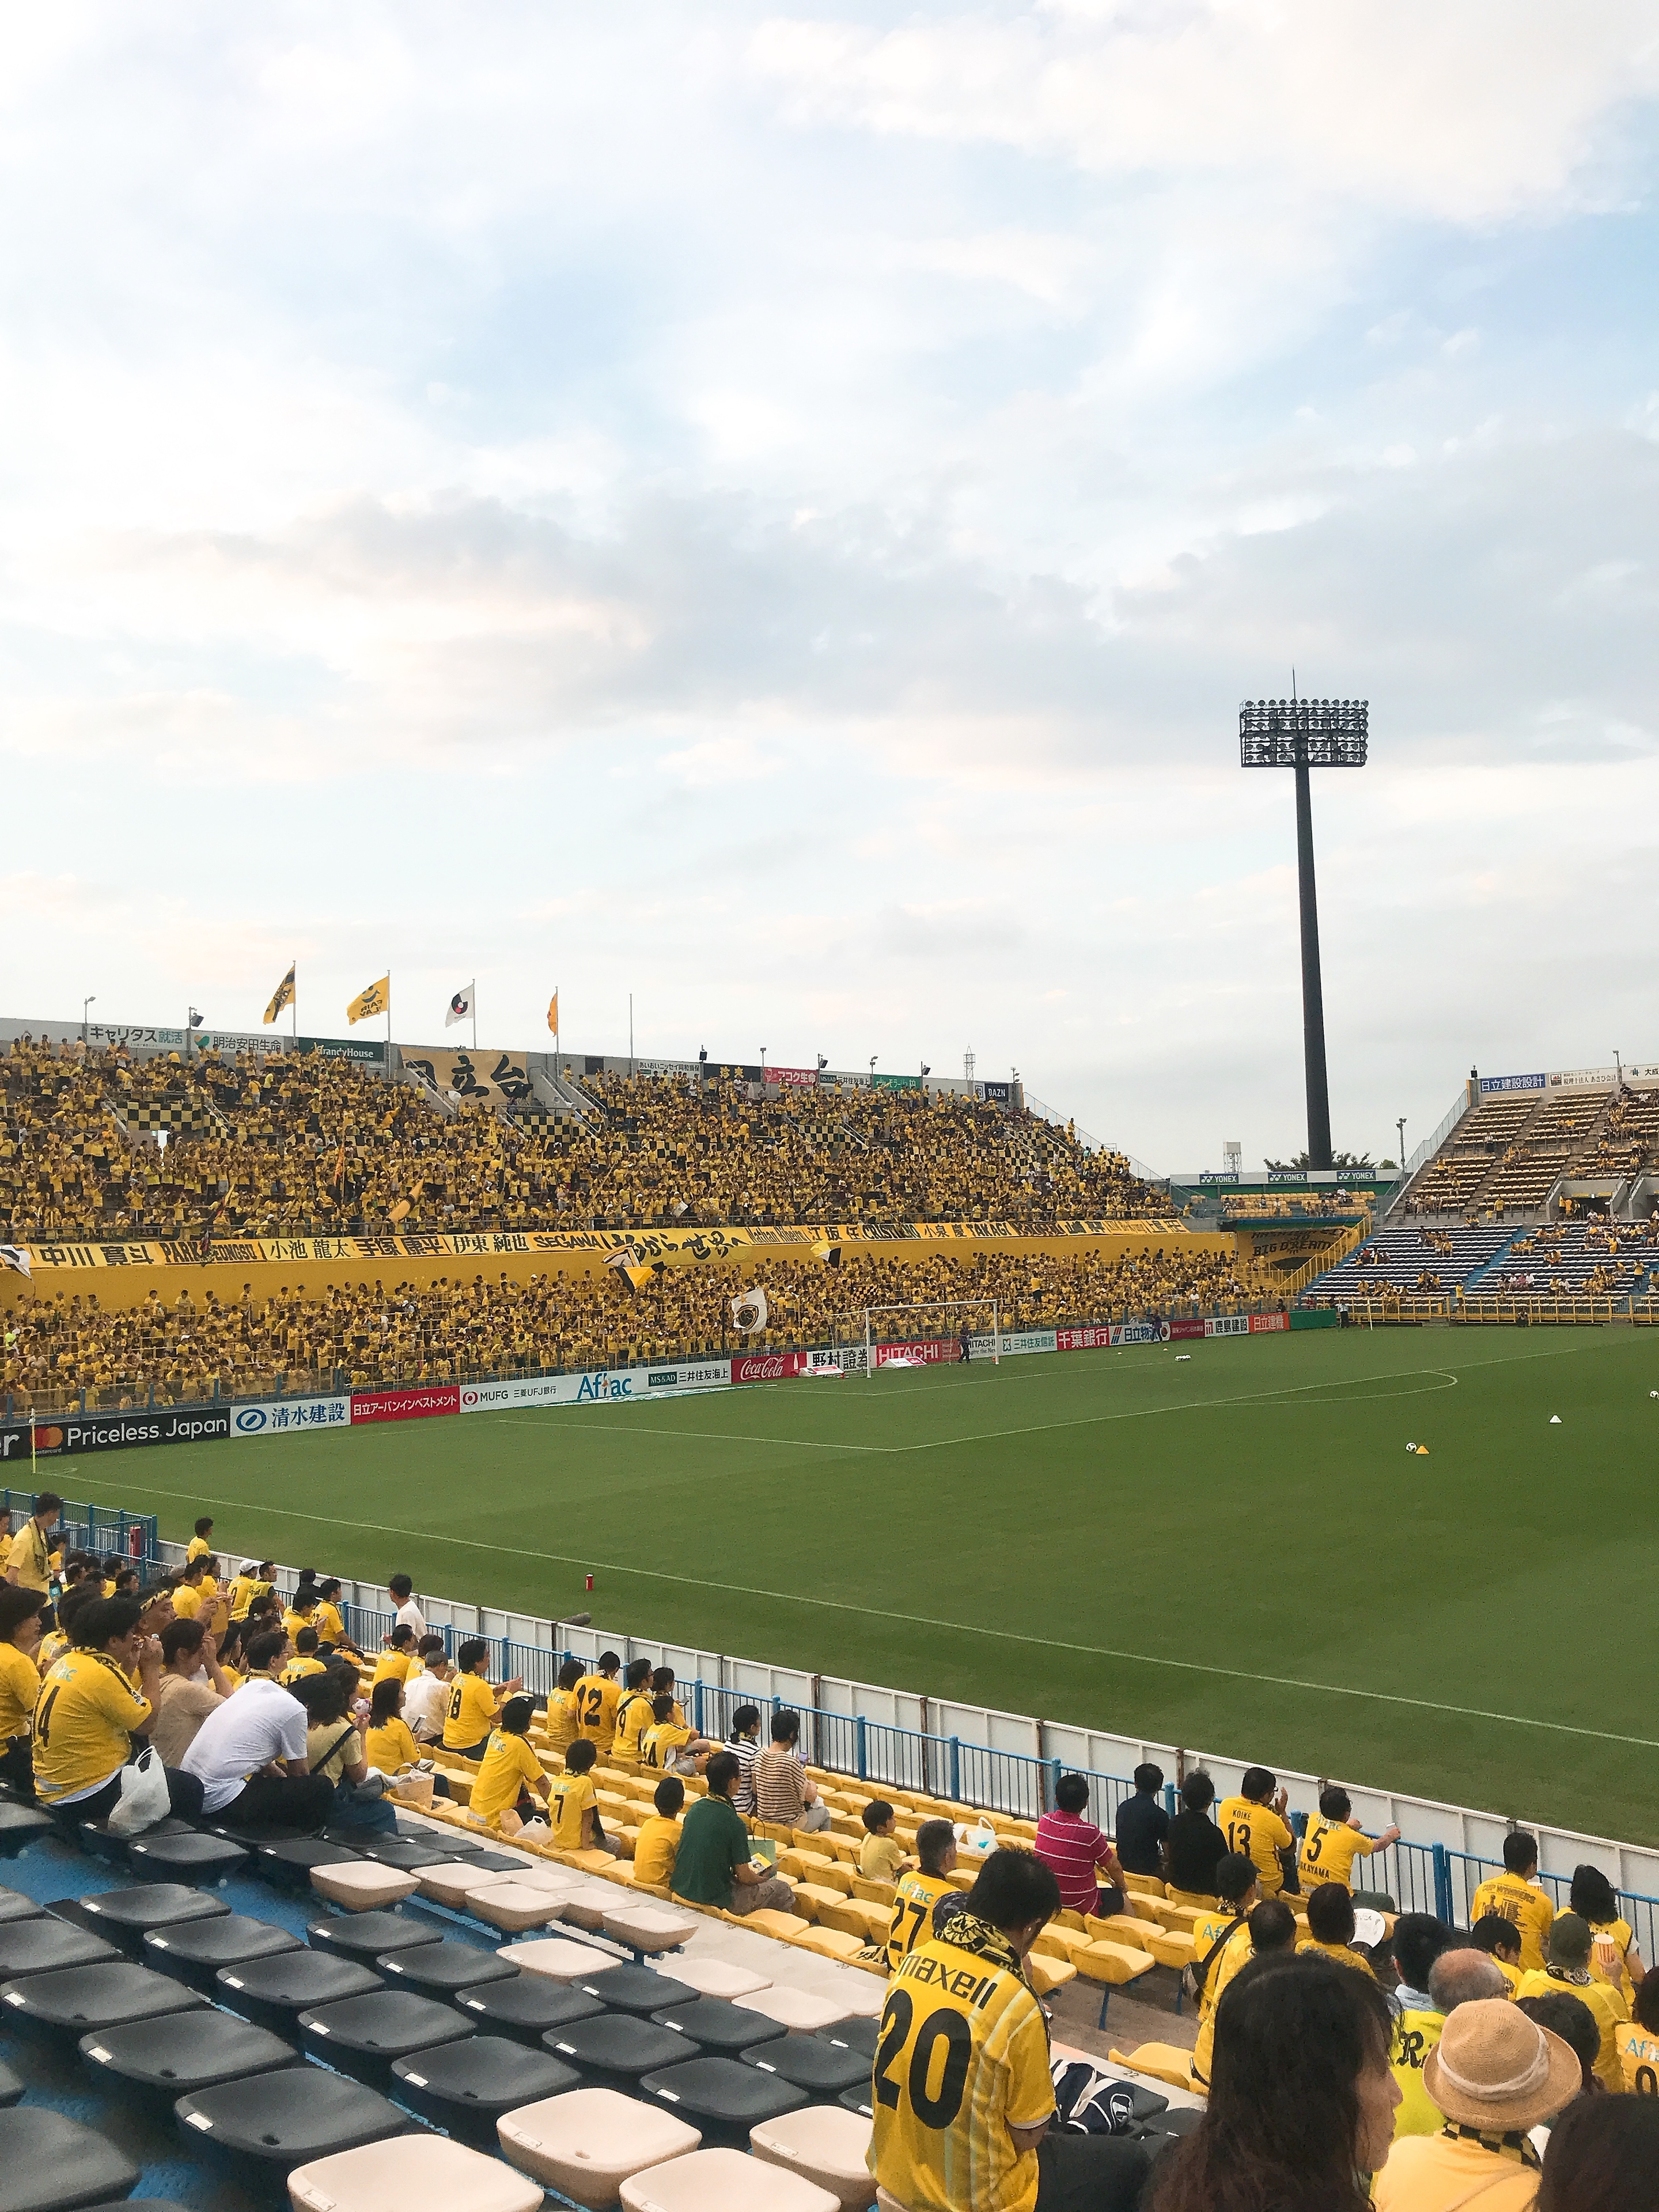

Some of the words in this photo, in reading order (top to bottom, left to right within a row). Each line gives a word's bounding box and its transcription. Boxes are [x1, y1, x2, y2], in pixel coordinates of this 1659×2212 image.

[90, 1026, 183, 1044] キャリタス就活
[214, 1036, 282, 1051] 明治安田生命
[778, 1071, 816, 1084] フコク生命
[1481, 1075, 1544, 1092] 日立建設設計
[988, 1088, 1006, 1097] DAZN
[1214, 1175, 1237, 1184] YONEX
[1283, 1173, 1306, 1182] YONEX
[1352, 1172, 1375, 1180] YONEX
[270, 1239, 308, 1259] 小池
[312, 1238, 352, 1259] 龍太
[453, 1235, 490, 1253] 伊東
[493, 1233, 530, 1252] 純也
[533, 1232, 600, 1250] SEGAWA
[39, 1245, 96, 1267] 中川
[158, 1241, 200, 1263] PARK
[1215, 1319, 1248, 1334] 鹿島建設
[1014, 1336, 1055, 1350] 三井住友信託
[1058, 1328, 1108, 1348] 千葉銀行
[878, 1344, 938, 1363] HITACHI
[577, 1372, 632, 1399] Aflac
[650, 1374, 676, 1384] MS&AD
[679, 1368, 729, 1382] 三井住友海上
[480, 1389, 509, 1402] MUFG
[514, 1385, 557, 1398] 三菱UFJ銀行
[353, 1395, 457, 1416] 日立アーバンインベストメント
[271, 1403, 346, 1428] 清水建設
[166, 1417, 227, 1439] Japan
[32, 1447, 62, 1456] astercard
[577, 1684, 604, 1727] 12
[554, 1794, 565, 1824] 7
[1233, 1809, 1252, 1821] KOIKE
[1228, 1821, 1251, 1858] 13
[1306, 1827, 1328, 1862] 5
[889, 1896, 928, 1955] 27
[897, 1954, 998, 2010] maxell
[874, 1988, 972, 2130] 20
